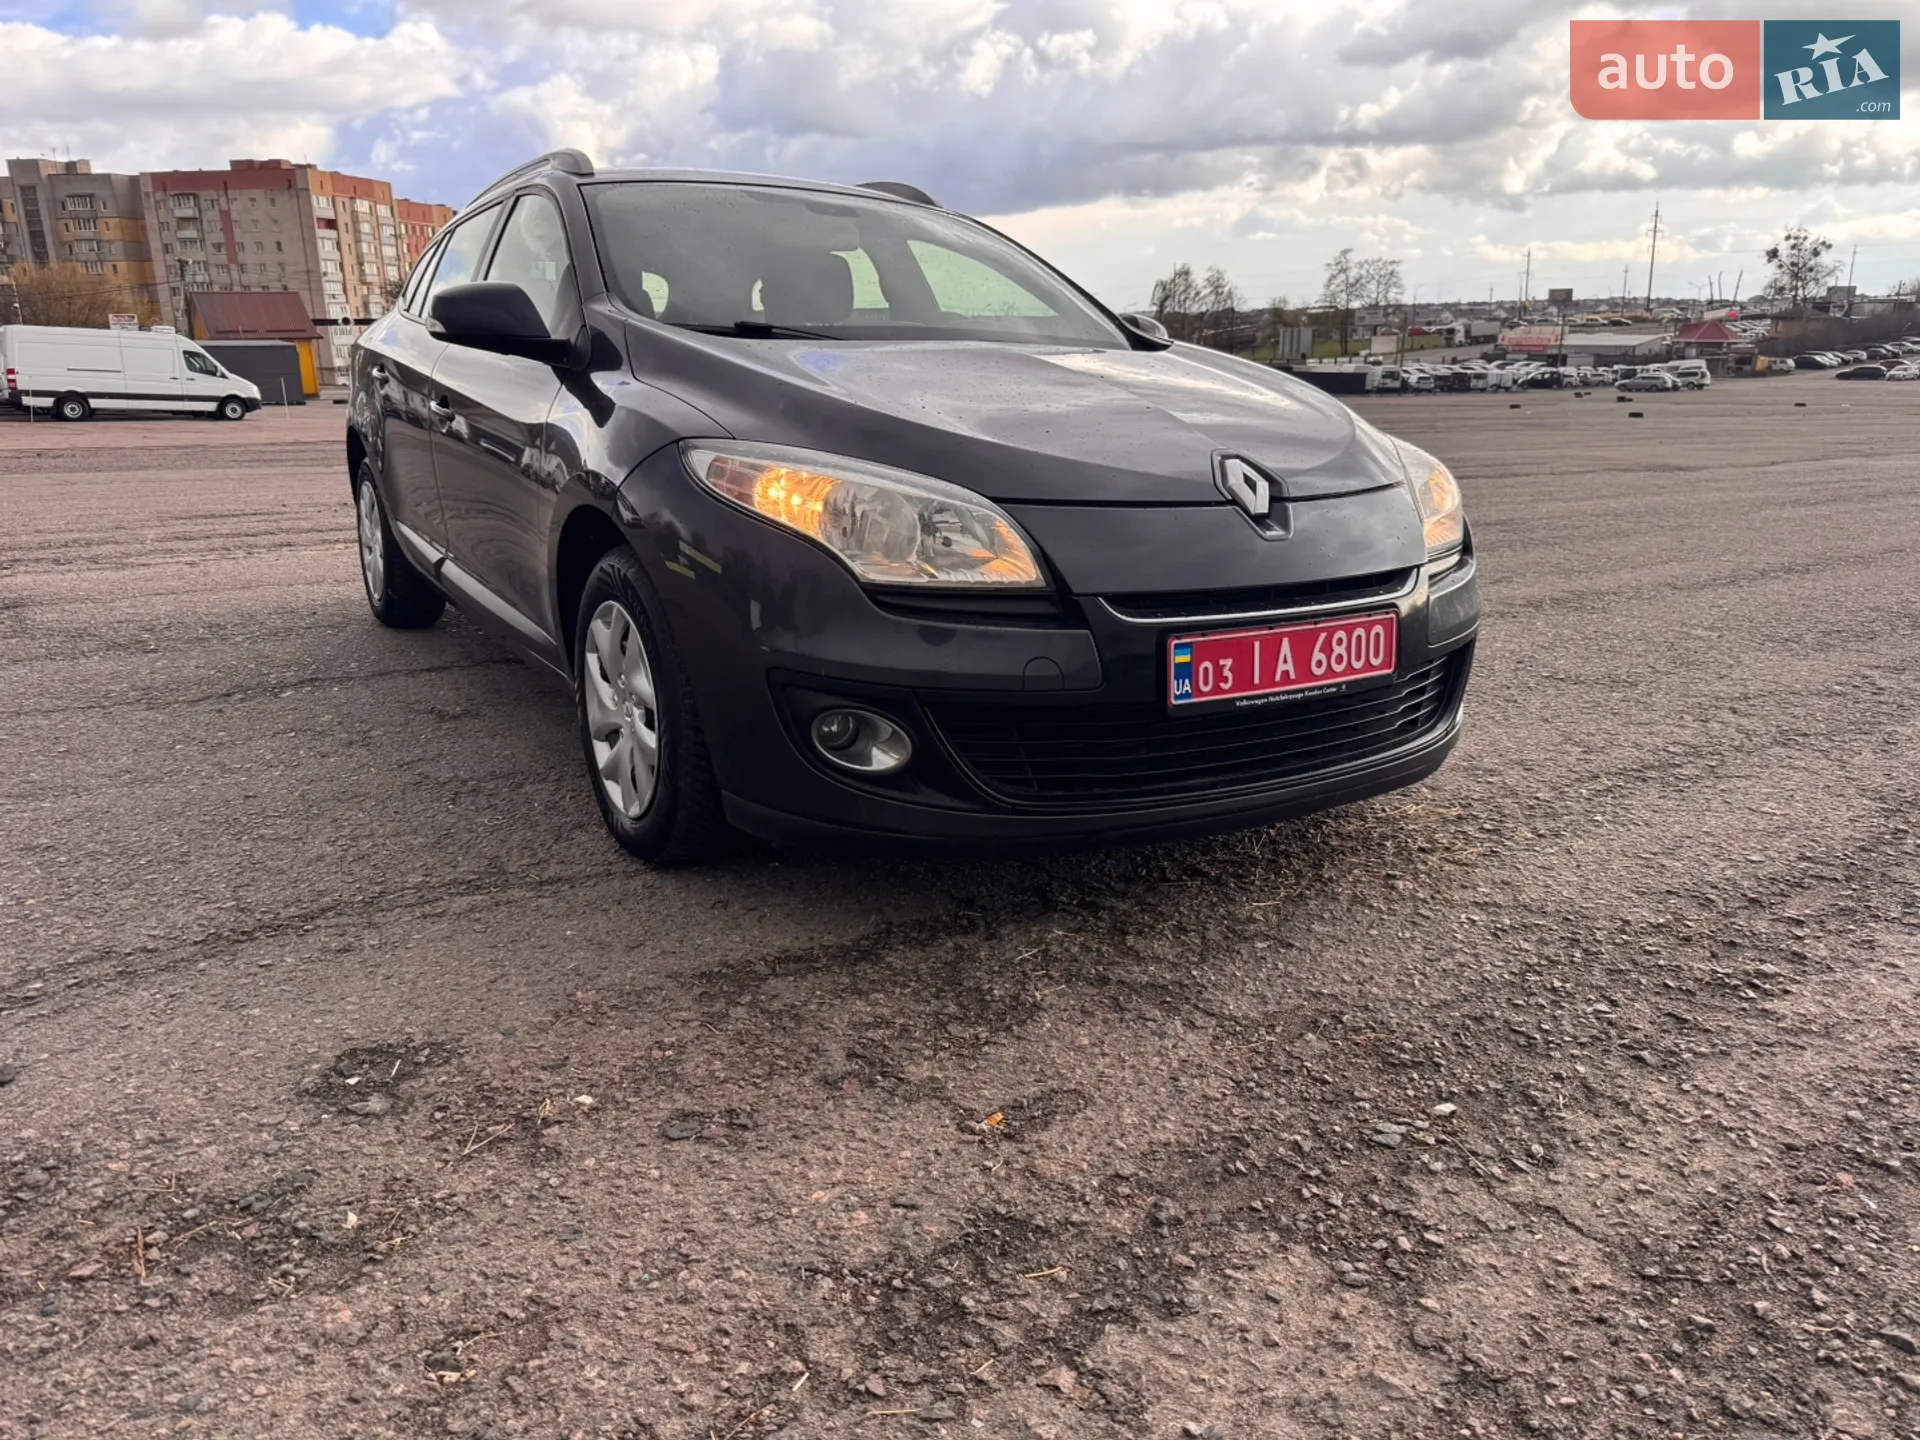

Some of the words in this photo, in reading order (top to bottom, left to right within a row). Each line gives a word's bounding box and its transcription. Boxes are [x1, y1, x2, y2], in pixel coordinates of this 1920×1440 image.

[1198, 657, 1234, 693] 03
[1253, 637, 1297, 686] IA
[1310, 624, 1385, 676] 6800
[1174, 678, 1192, 695] UA
